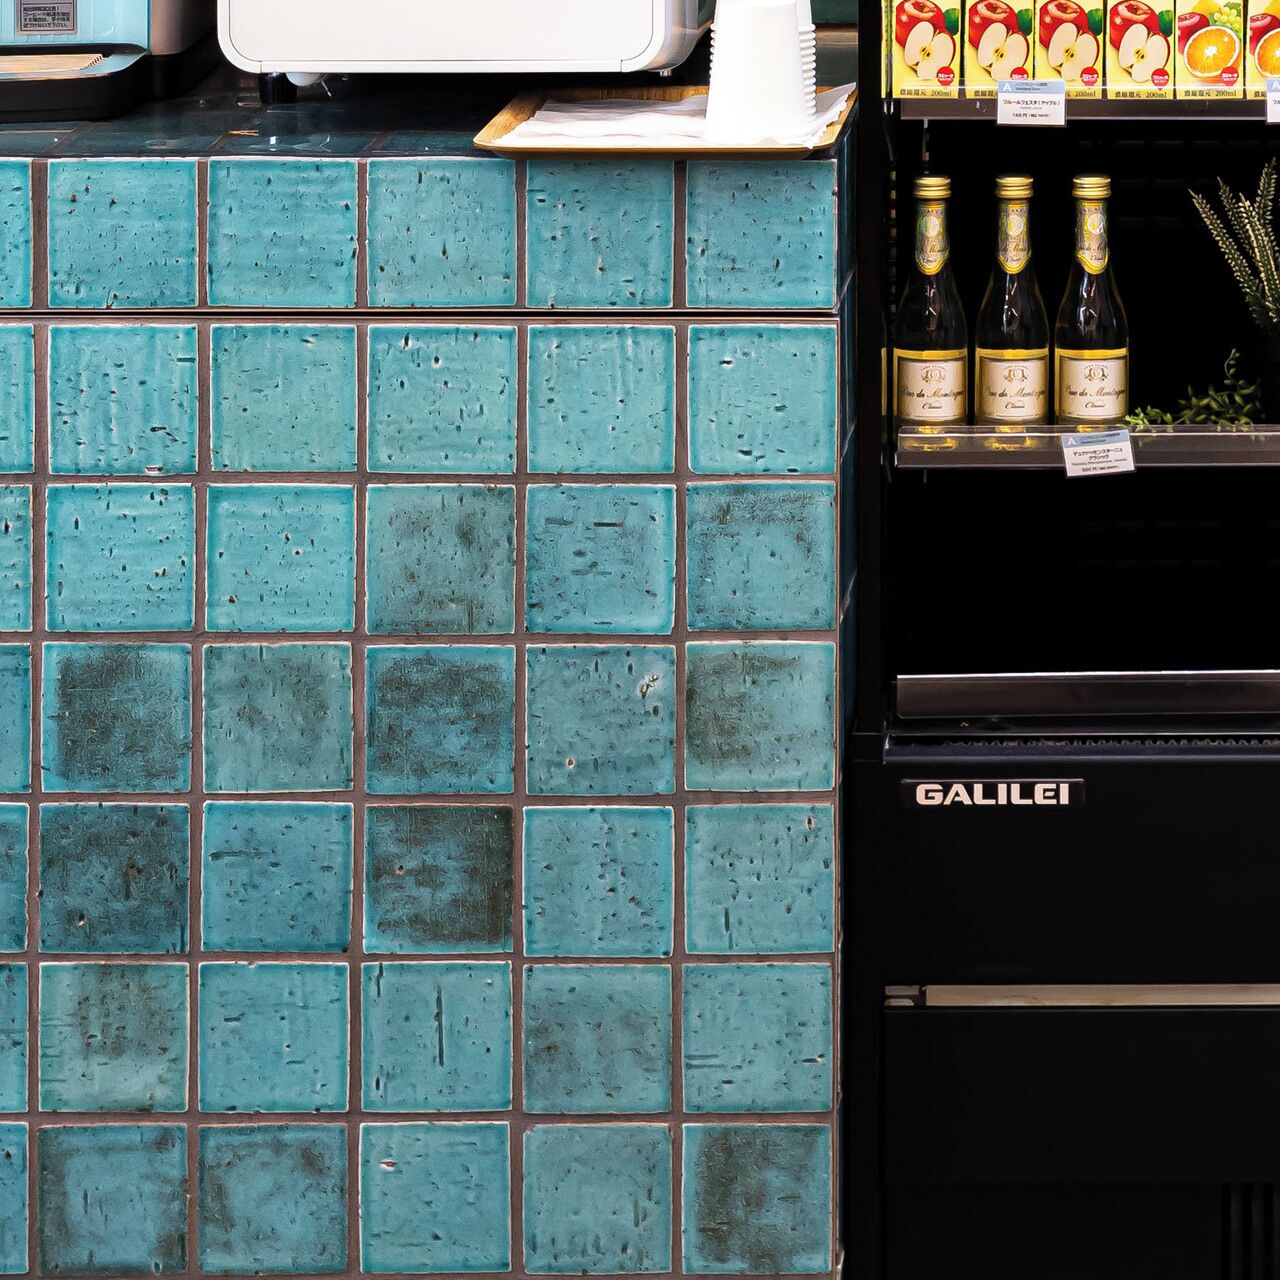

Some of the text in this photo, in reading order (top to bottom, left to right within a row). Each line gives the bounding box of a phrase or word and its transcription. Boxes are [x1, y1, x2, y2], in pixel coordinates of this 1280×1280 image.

[930, 89, 952, 97] 200ml
[1215, 89, 1237, 97] 200ml
[916, 783, 1069, 805] GALILEI
